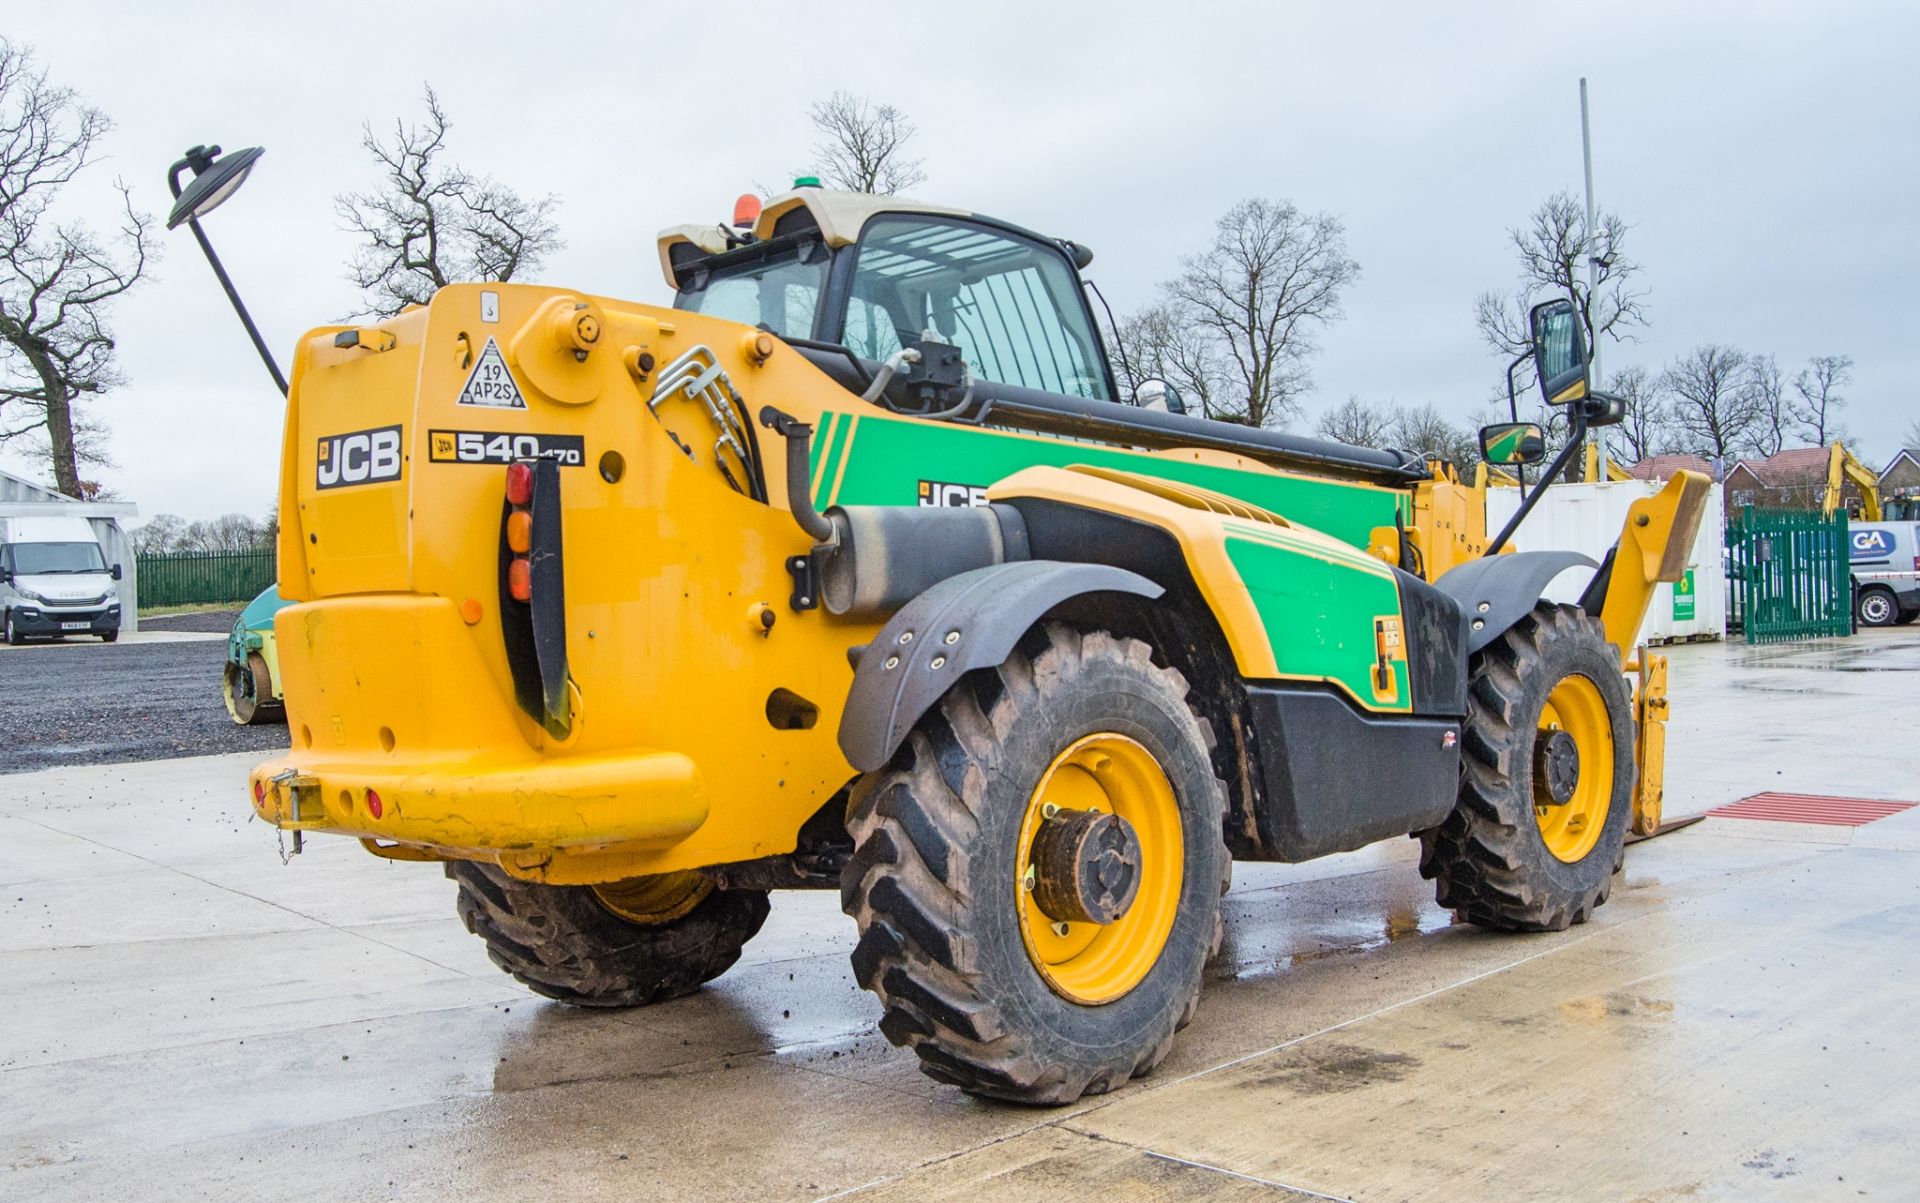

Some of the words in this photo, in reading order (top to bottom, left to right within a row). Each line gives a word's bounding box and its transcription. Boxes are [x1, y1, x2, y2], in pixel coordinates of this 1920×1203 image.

[484, 364, 501, 381] 19
[473, 381, 512, 400] AP2S
[318, 430, 401, 486] JCB
[1853, 531, 1887, 550] GA
